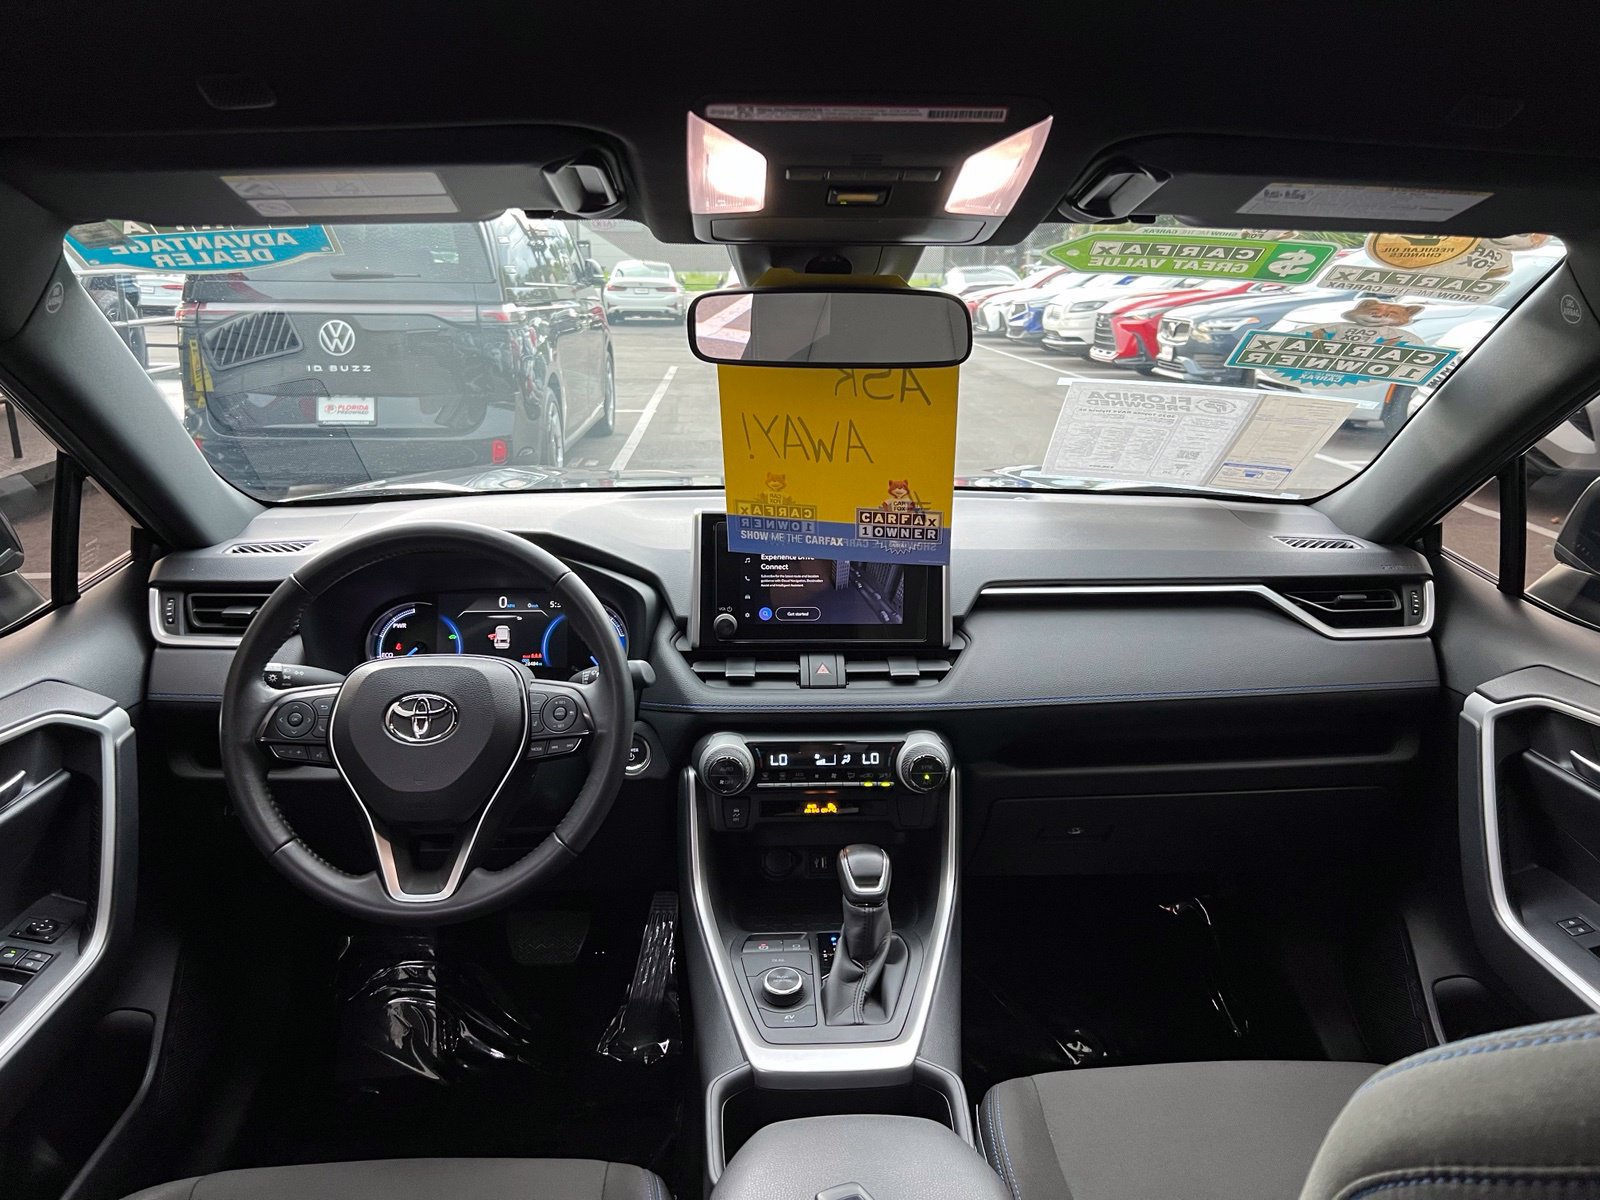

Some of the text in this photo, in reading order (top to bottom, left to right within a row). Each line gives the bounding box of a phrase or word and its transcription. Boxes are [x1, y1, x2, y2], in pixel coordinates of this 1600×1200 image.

[861, 512, 937, 527] CARFAX
[740, 529, 844, 547] SHOW ME THE CARFAX
[874, 528, 936, 539] OWNER
[498, 596, 508, 609] 0
[770, 753, 788, 766] LO
[862, 752, 880, 765] LO
